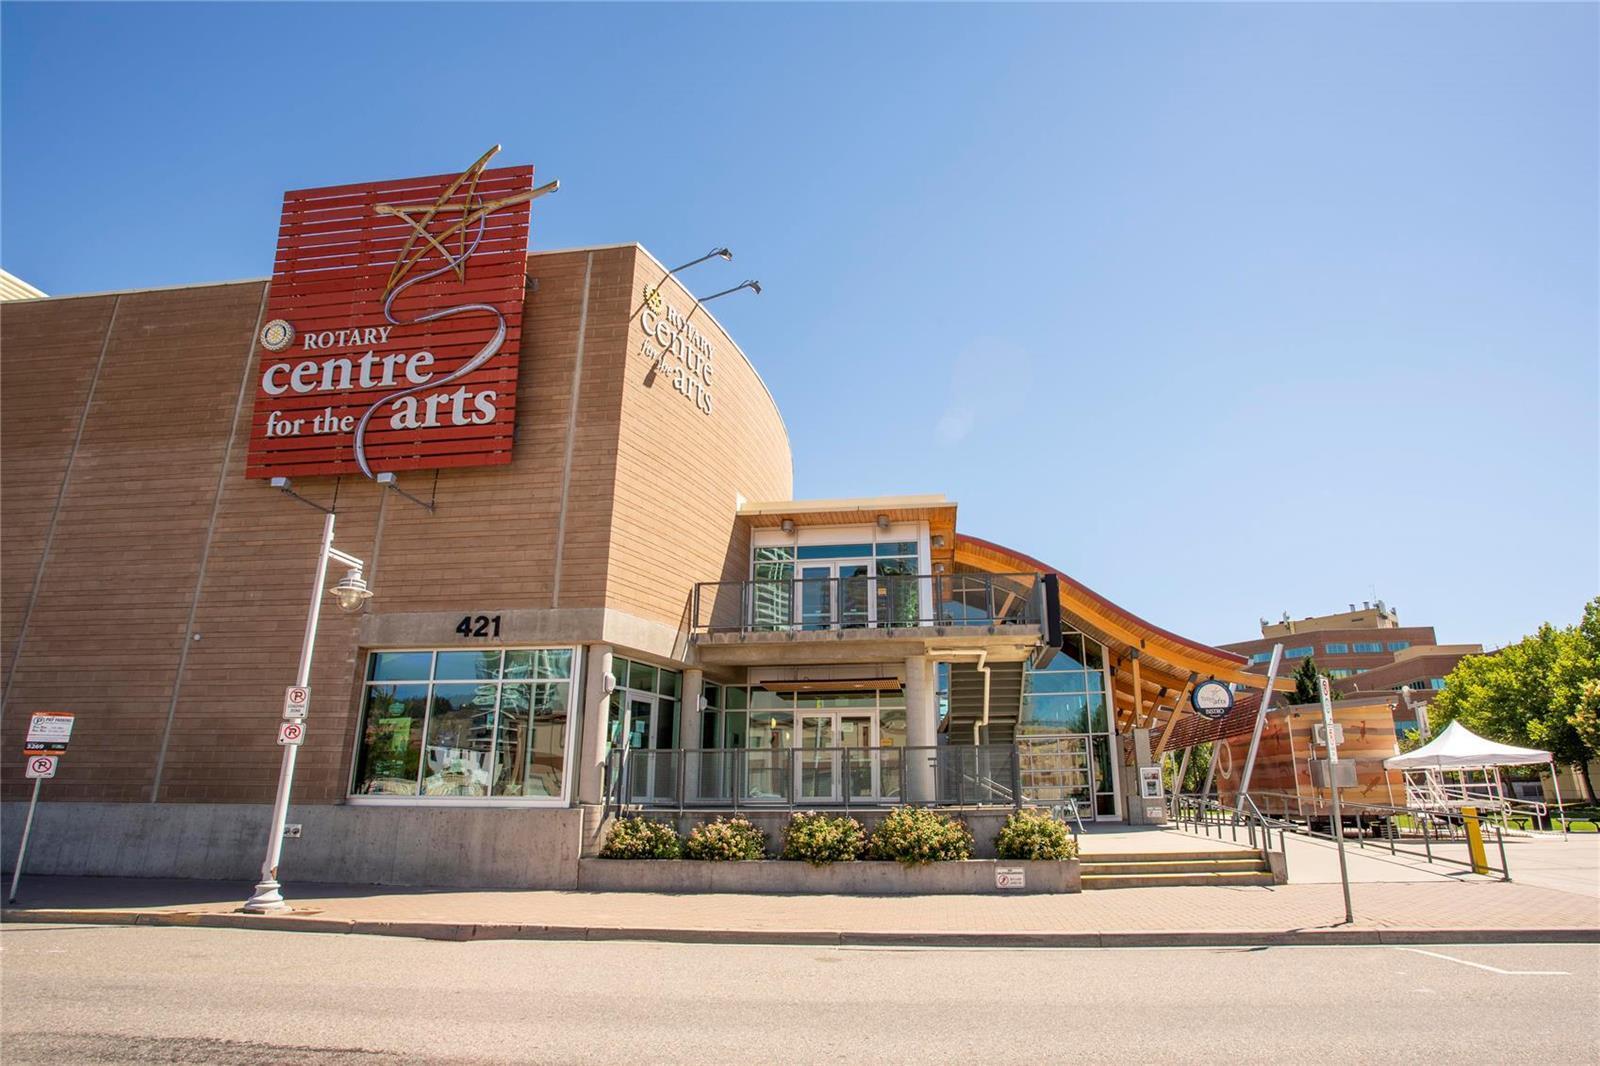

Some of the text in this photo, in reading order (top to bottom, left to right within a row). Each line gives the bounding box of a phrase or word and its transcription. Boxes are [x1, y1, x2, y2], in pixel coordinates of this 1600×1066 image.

[303, 326, 393, 350] ROTARY
[261, 350, 435, 395] centre
[672, 367, 712, 416] arts
[265, 386, 497, 437] for the arts
[456, 615, 501, 637] 421
